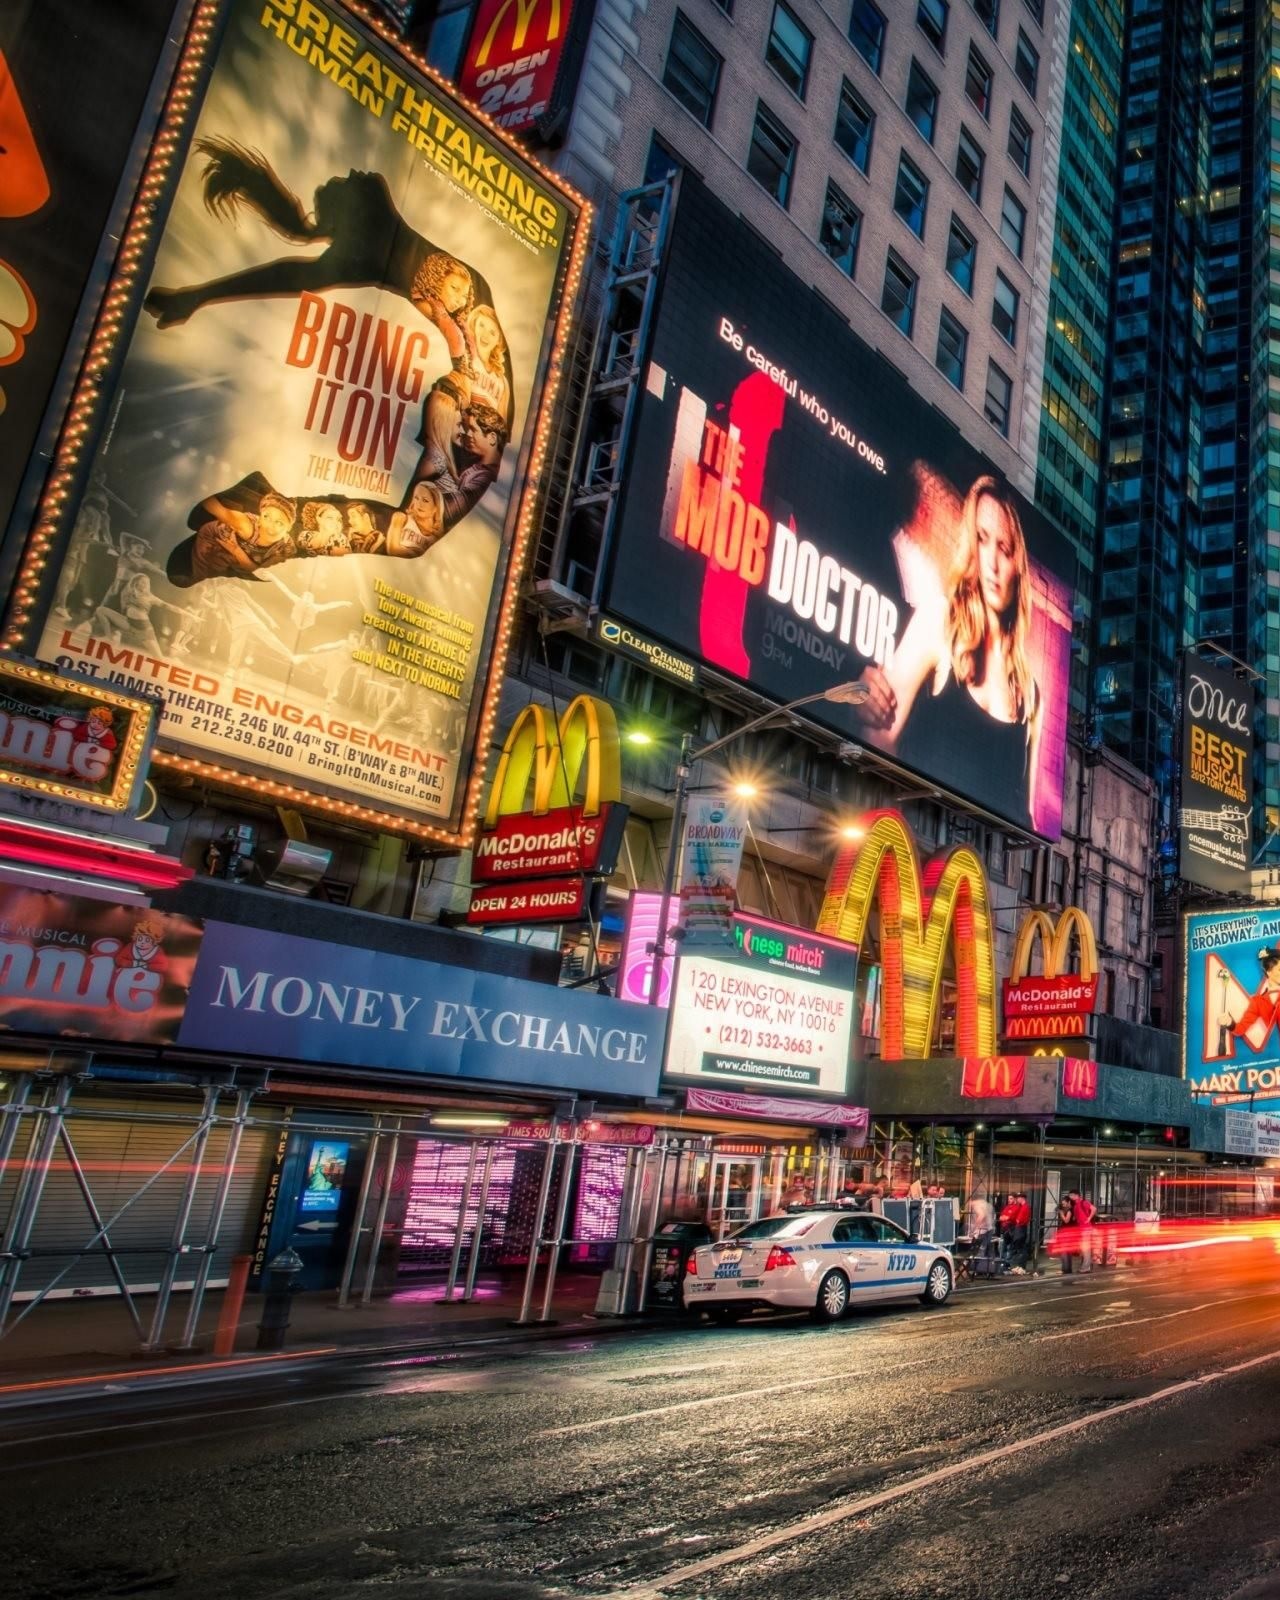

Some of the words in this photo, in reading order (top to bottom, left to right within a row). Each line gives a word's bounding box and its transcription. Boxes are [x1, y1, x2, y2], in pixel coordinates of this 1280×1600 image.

[260, 5, 385, 118] HUMAN
[476, 49, 550, 88] OPEN
[480, 73, 536, 114] 24
[269, 0, 558, 230] BREATHTAKING
[423, 159, 444, 182] THE
[448, 180, 474, 203] NEW
[478, 202, 506, 231] YORK
[510, 229, 539, 255] TIMES
[286, 290, 430, 404] BRING
[719, 317, 744, 351] Be
[746, 345, 799, 398] careful
[800, 389, 830, 425] who
[831, 417, 857, 448] you
[857, 440, 888, 475] owe.
[304, 378, 344, 435] IT
[337, 389, 406, 472] ON
[703, 418, 747, 488] THE
[307, 454, 333, 482] THE
[334, 463, 392, 496] MUSICAL
[673, 457, 771, 587] MOB
[767, 521, 899, 670] DOCTOR
[374, 577, 393, 598] The
[393, 590, 415, 607] new
[415, 598, 452, 625] musical
[452, 613, 475, 634] from
[378, 596, 401, 620] Tony
[362, 612, 406, 640] creators
[406, 631, 418, 644] of
[418, 633, 458, 662] AVENUE
[762, 635, 793, 670] 9PM
[765, 608, 847, 672] MONDAY
[352, 648, 373, 666] and
[374, 654, 404, 678] NEXT
[404, 664, 420, 684] TO
[419, 671, 461, 700] NORMAL
[387, 640, 401, 657] IN
[401, 645, 421, 666] THE
[422, 654, 466, 683] HEIGHTS
[649, 656, 695, 683] SPECTACOLOR
[60, 630, 220, 696] LIMITED
[232, 687, 449, 773] ENGAGEMENT
[103, 670, 163, 699] JAMES
[168, 689, 236, 726] THEATRE,
[239, 712, 269, 733] 246
[272, 722, 291, 742] W.
[293, 731, 322, 748] 44TH
[323, 741, 341, 758] ST.
[389, 765, 397, 776] &
[191, 715, 294, 759] 212.239.6200
[1191, 725, 1248, 776] BEST
[308, 752, 443, 806] BringItOnMusical.com
[1190, 769, 1207, 785] 2012
[1207, 776, 1225, 793] TONY
[1224, 784, 1248, 804] AWARD
[1191, 754, 1247, 793] MUSICAL
[477, 826, 598, 858] McDonald's
[688, 824, 744, 841] BROADWAY
[1188, 832, 1247, 863] oncemusical.com
[493, 852, 572, 871] Restaurant
[471, 897, 507, 913] OPEN
[510, 896, 527, 910] 24
[530, 891, 578, 908] HOURS
[16, 925, 87, 946] MUSICAL
[1194, 927, 1210, 937] IT'S
[1210, 916, 1258, 933] EVERYTHING
[787, 943, 822, 969] mirch
[690, 969, 717, 991] 120
[721, 976, 796, 1007] LEXINGTON
[799, 995, 846, 1018] AVENUE
[694, 992, 731, 1013] NEW
[735, 1001, 774, 1026] YORK,
[777, 1009, 797, 1025] NY
[800, 1013, 837, 1034] 10016
[1007, 986, 1093, 1002] McDonald's
[1021, 1002, 1077, 1012] Restaurant
[210, 964, 420, 1033] MONEY
[429, 1000, 648, 1065] EXCHANGE
[719, 1025, 753, 1048] (212)
[756, 1031, 813, 1056] 532-3663
[716, 1058, 811, 1081] www.chinesemirch.com
[1191, 1070, 1243, 1097] MARY
[507, 1126, 531, 1138] TIMES
[252, 1174, 281, 1276] EXCHANGE
[714, 1269, 742, 1278] POLICE
[887, 1253, 917, 1272] NYPD
